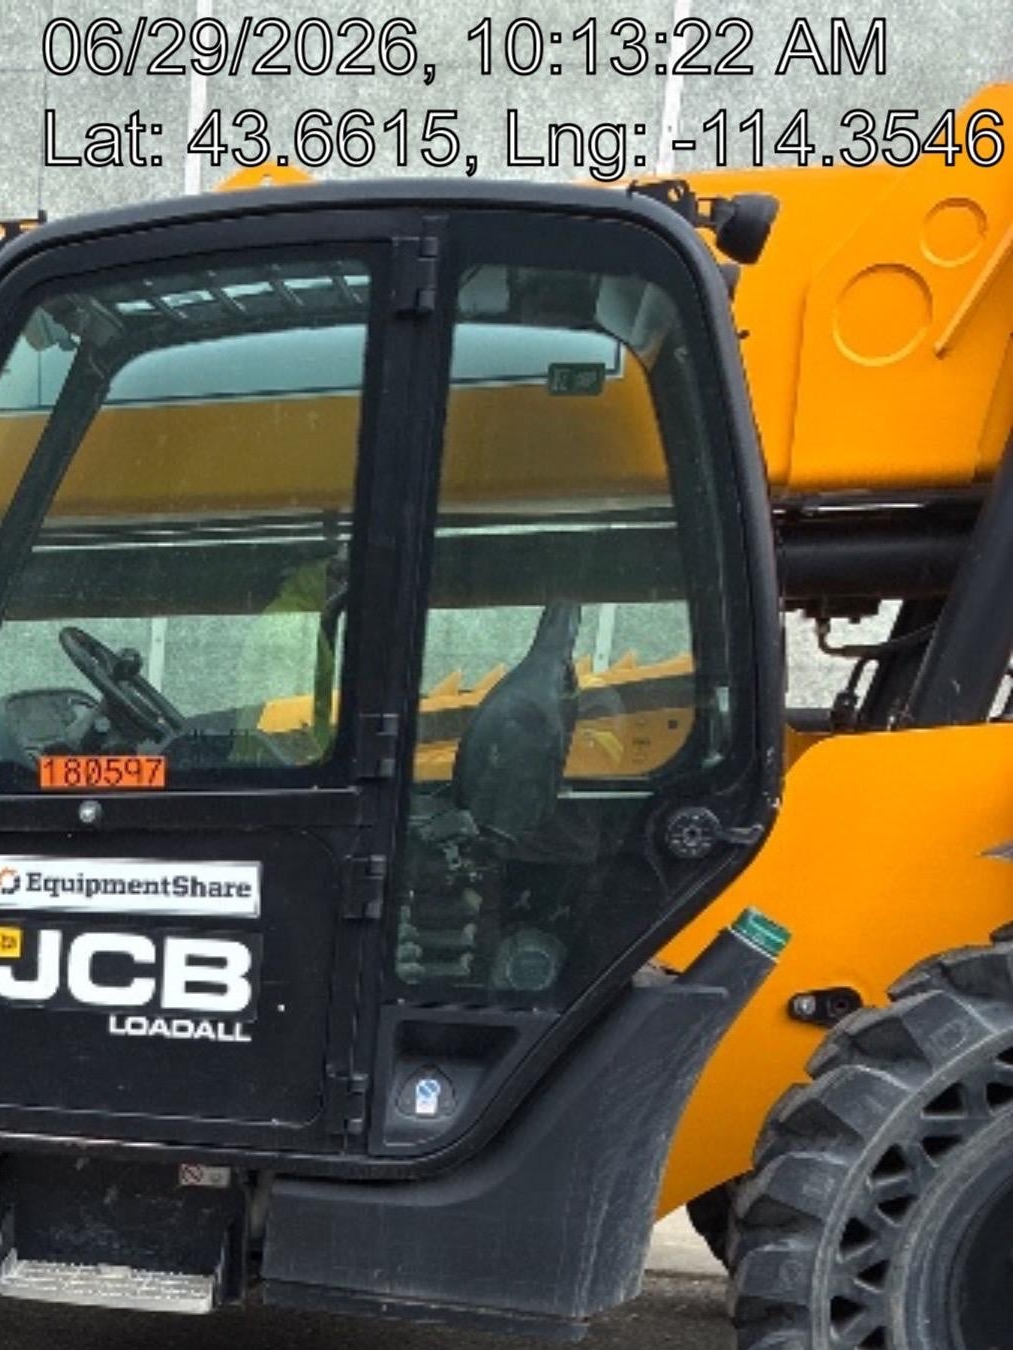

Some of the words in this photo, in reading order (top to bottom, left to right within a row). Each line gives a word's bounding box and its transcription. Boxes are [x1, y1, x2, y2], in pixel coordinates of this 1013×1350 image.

[43, 757, 163, 787] 180597
[25, 871, 252, 899] EquipmentShare
[109, 1014, 252, 1042] LOADALL
